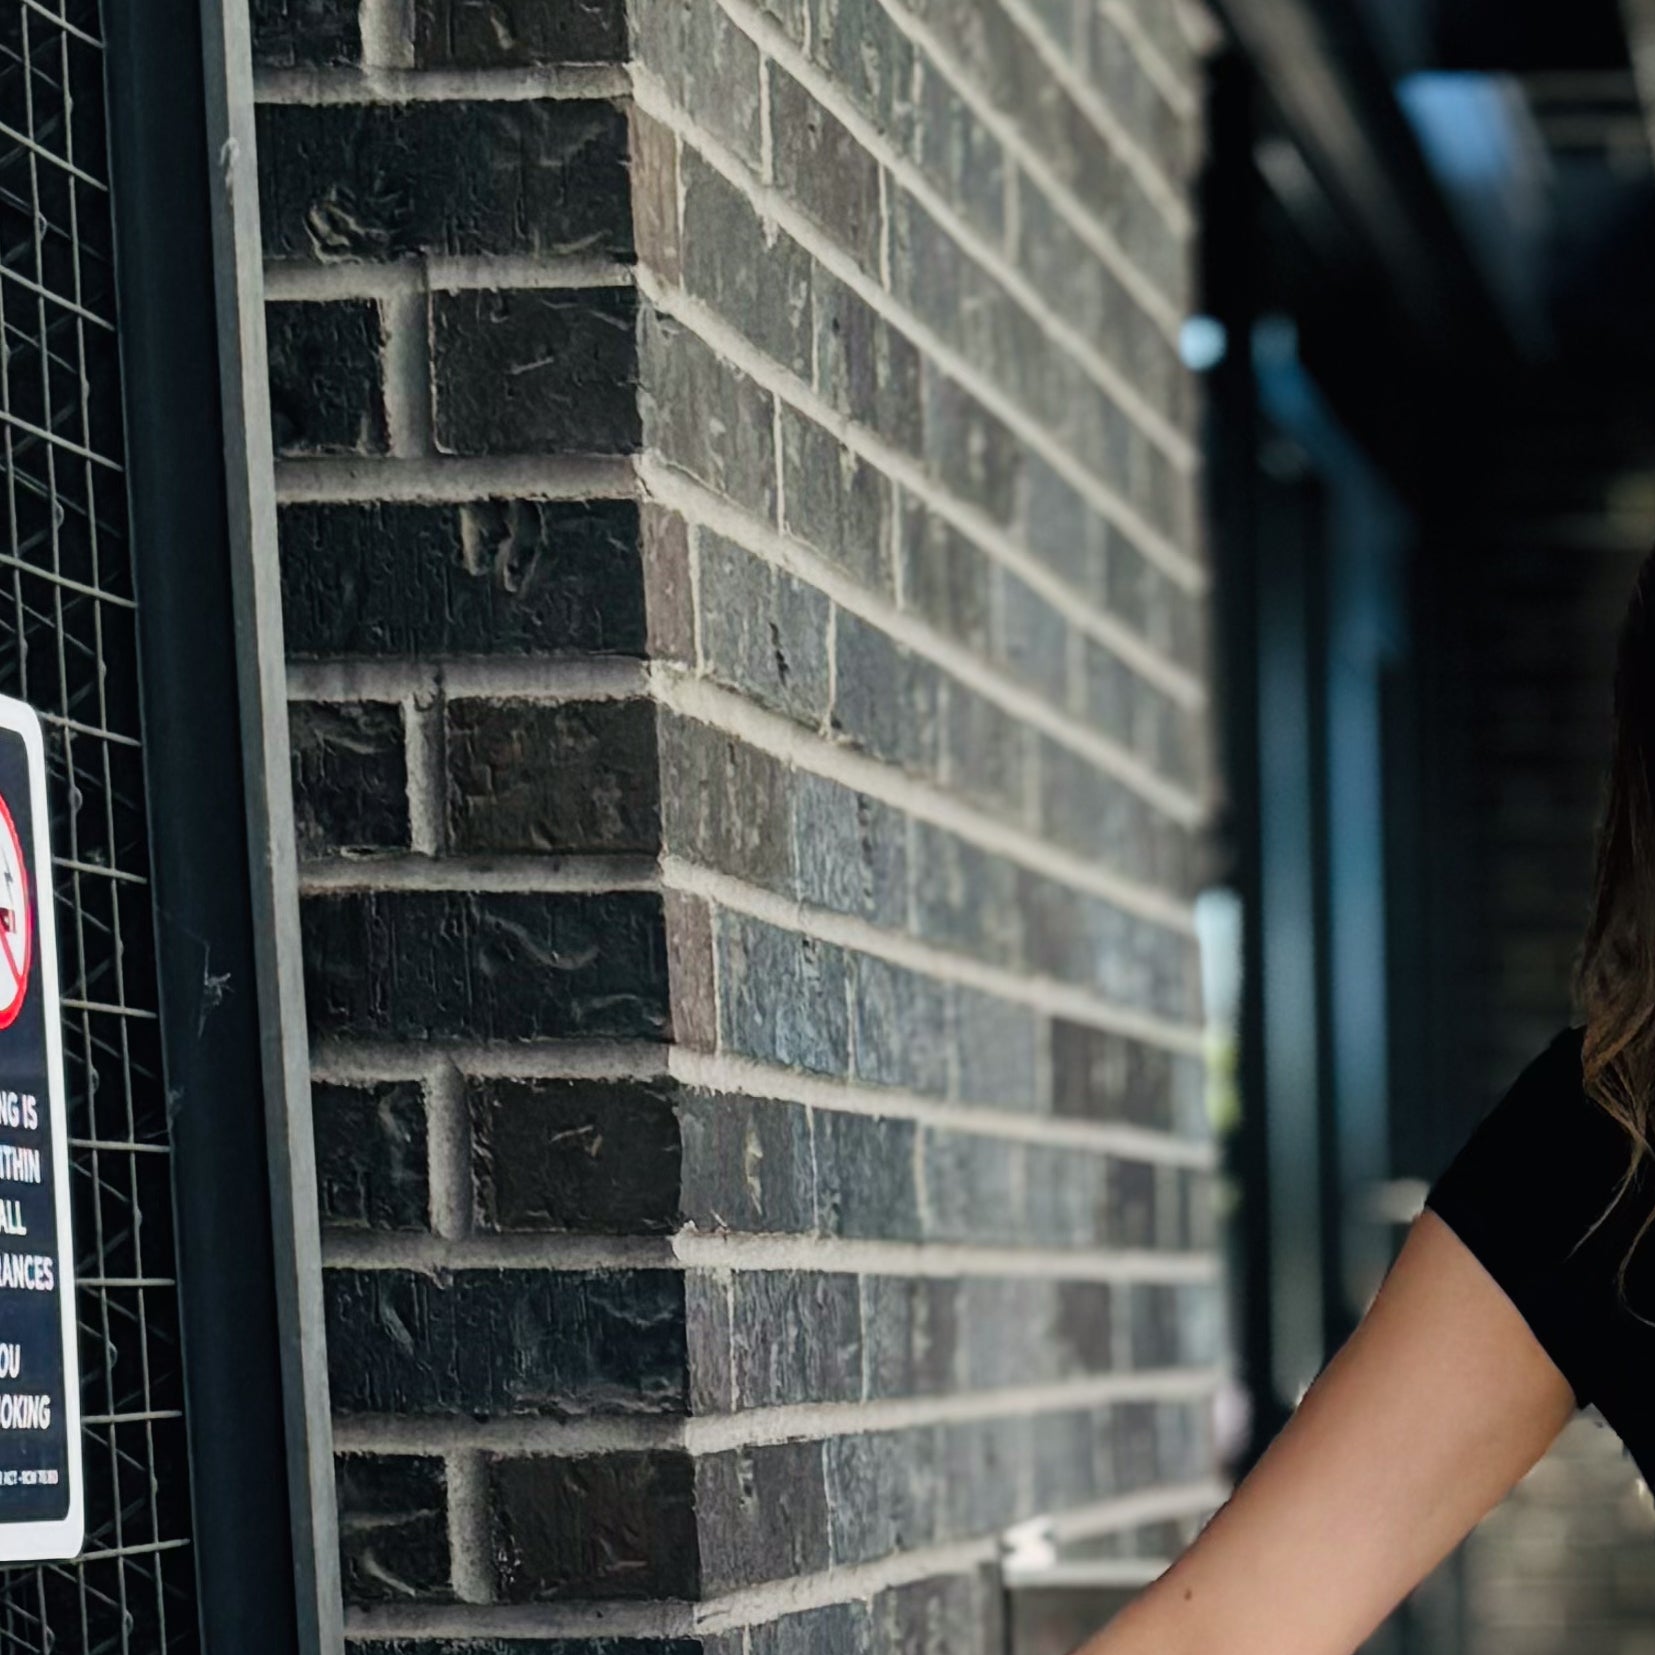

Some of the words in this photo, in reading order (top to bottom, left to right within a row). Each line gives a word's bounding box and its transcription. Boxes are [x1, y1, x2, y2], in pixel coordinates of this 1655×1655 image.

[22, 1094, 38, 1130] IS
[0, 1198, 27, 1236] ALL
[0, 1393, 51, 1430] OKING
